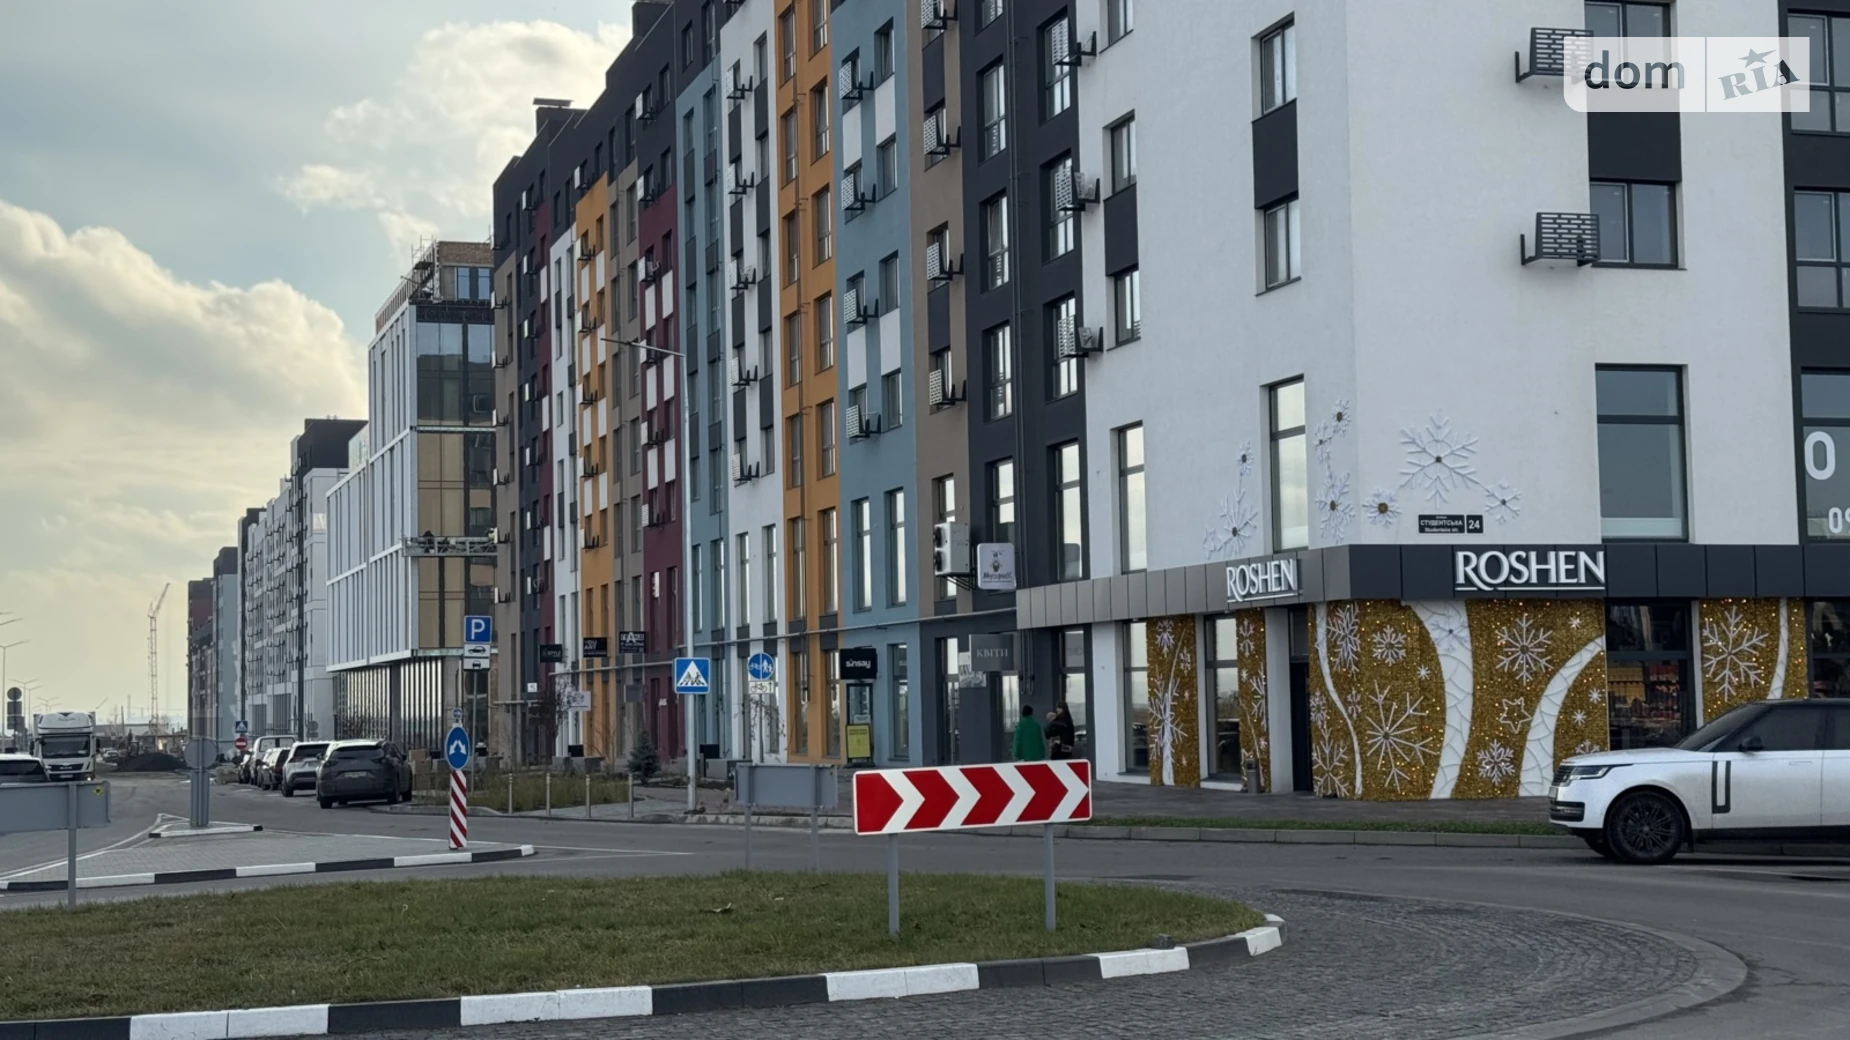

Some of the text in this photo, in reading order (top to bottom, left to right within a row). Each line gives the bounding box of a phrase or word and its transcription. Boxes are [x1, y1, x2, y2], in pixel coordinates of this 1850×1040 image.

[1468, 519, 1481, 530] 24
[1455, 551, 1606, 591] ROSHEN
[1226, 558, 1298, 602] ROSHEN
[471, 619, 485, 639] P
[976, 648, 1008, 657] КВІТИ
[845, 658, 871, 669] sinsay
